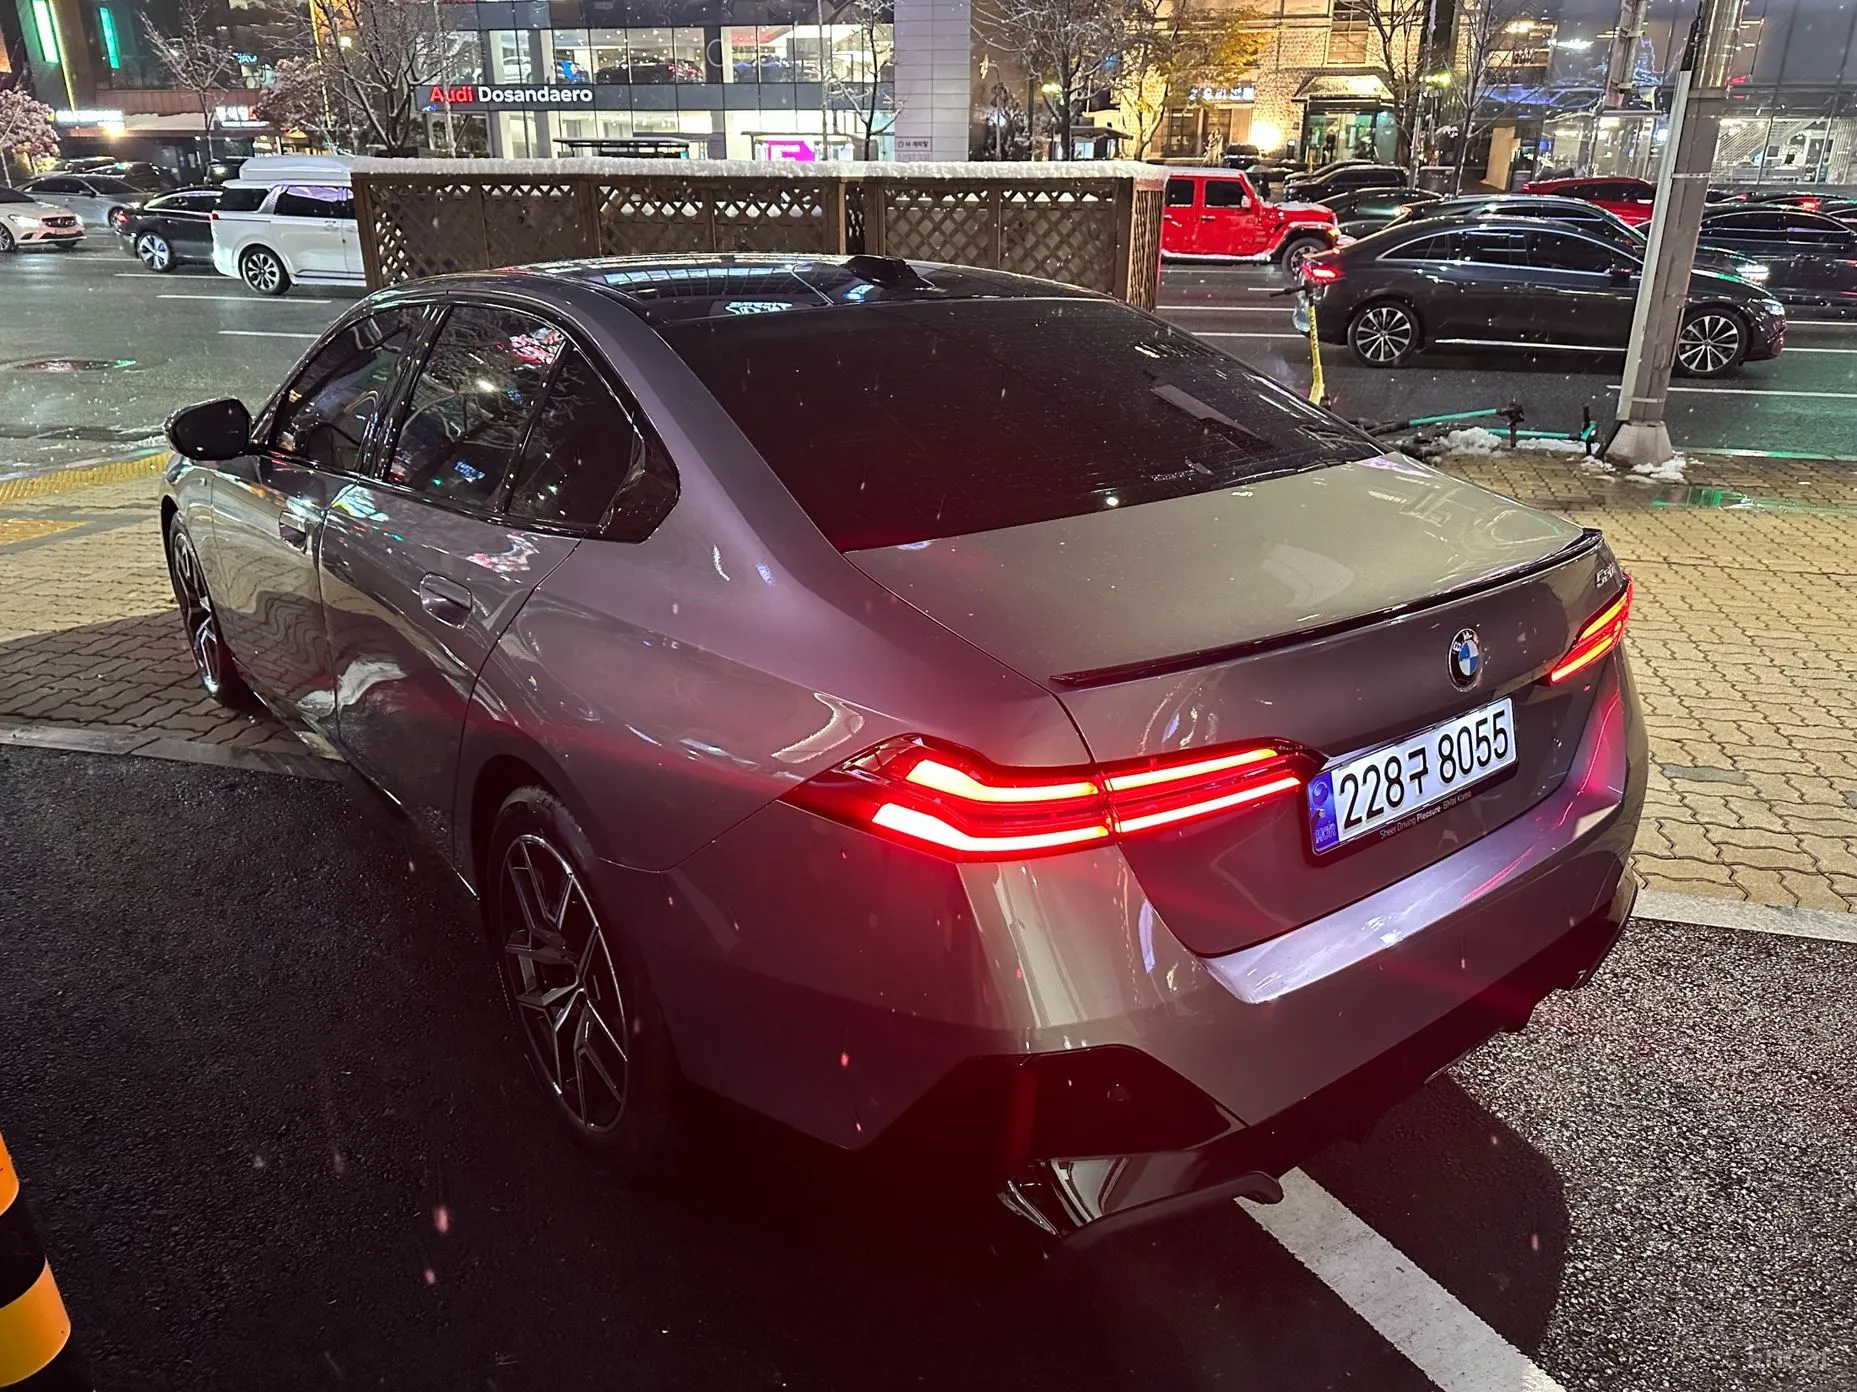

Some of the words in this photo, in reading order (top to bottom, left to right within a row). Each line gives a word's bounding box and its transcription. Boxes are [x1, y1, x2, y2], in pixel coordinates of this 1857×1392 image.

[430, 86, 473, 103] Audi
[478, 86, 593, 103] Dosandaero
[1339, 746, 1428, 829] 228구
[1438, 709, 1508, 784] 8055
[1380, 826, 1396, 839] Sheer
[1397, 817, 1416, 831] Driving
